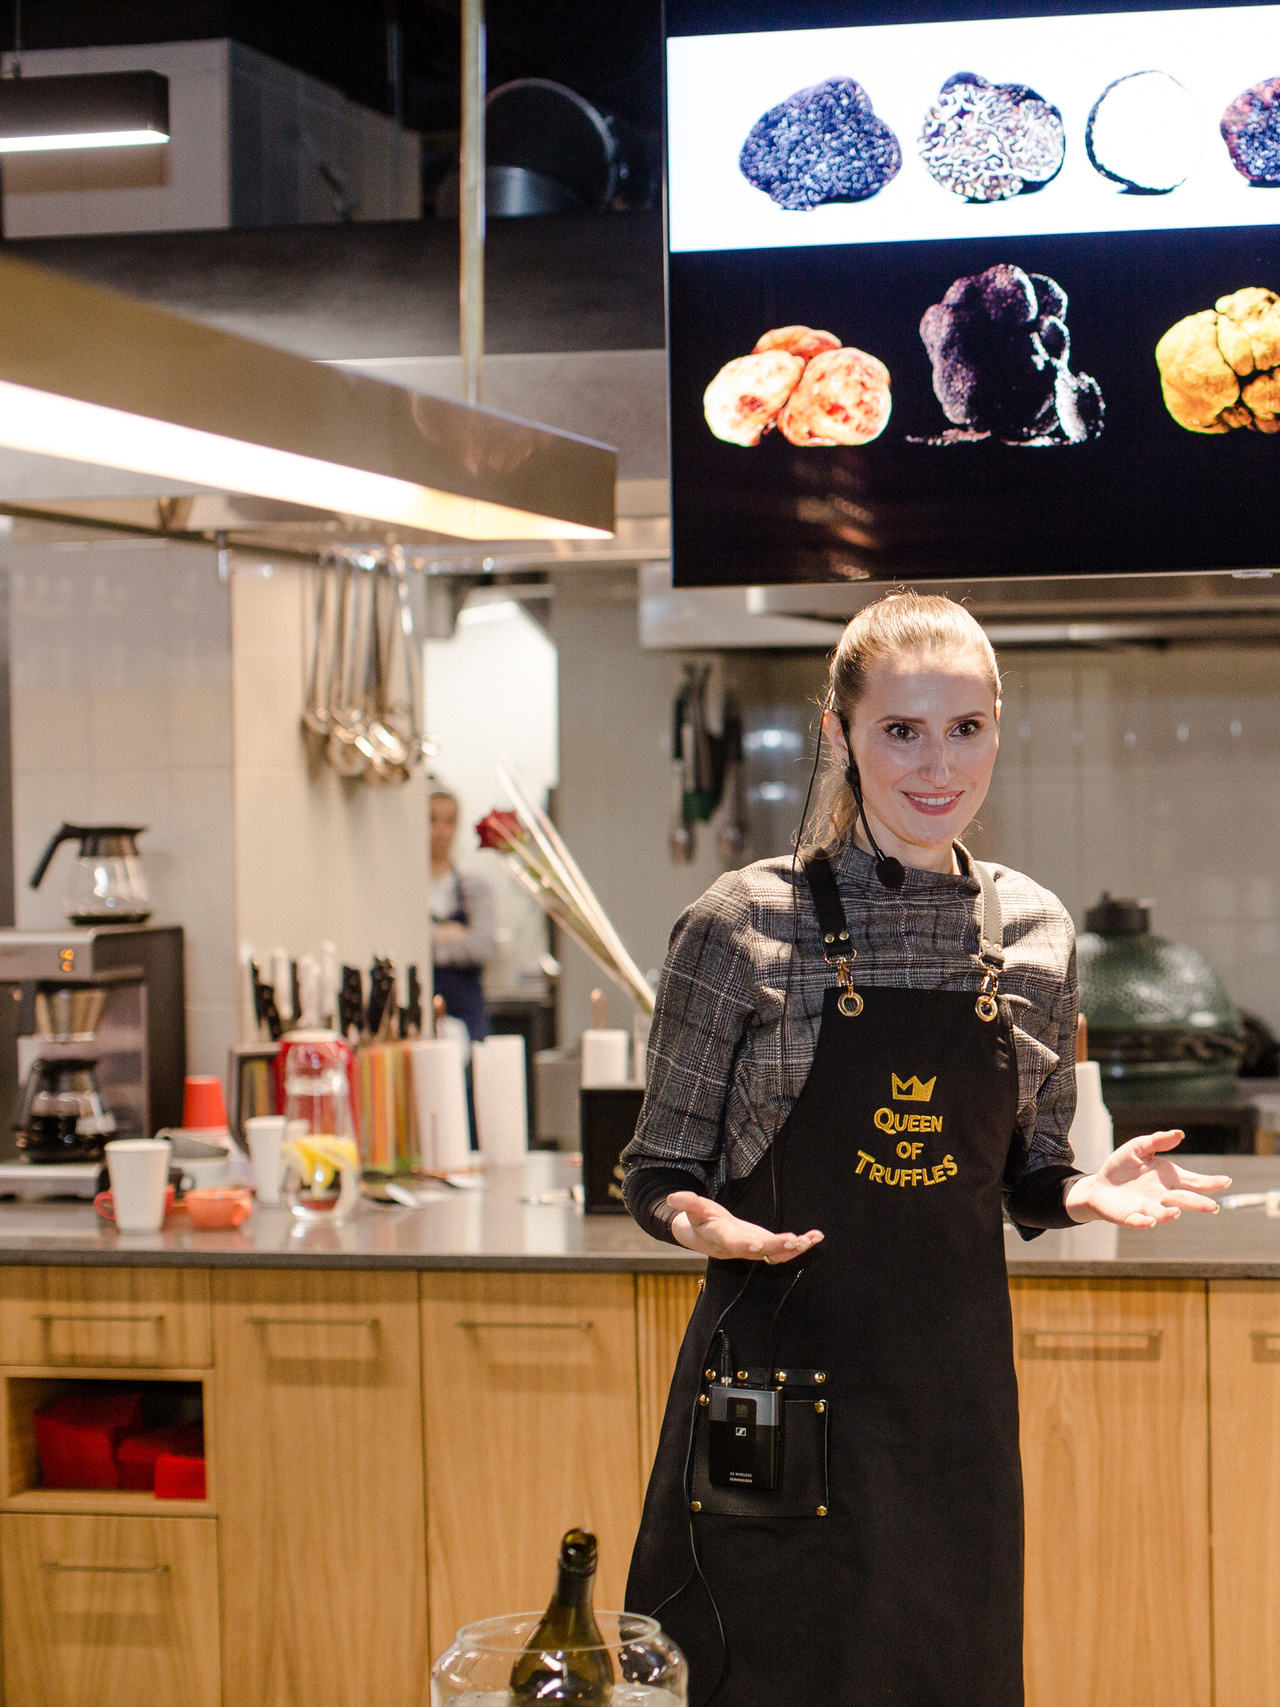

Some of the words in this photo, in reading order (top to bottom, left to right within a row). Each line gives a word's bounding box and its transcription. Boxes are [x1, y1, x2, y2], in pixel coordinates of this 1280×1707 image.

[873, 1107, 943, 1135] QUEEN
[896, 1141, 924, 1160] OF
[855, 1149, 958, 1187] TRUFFLES
